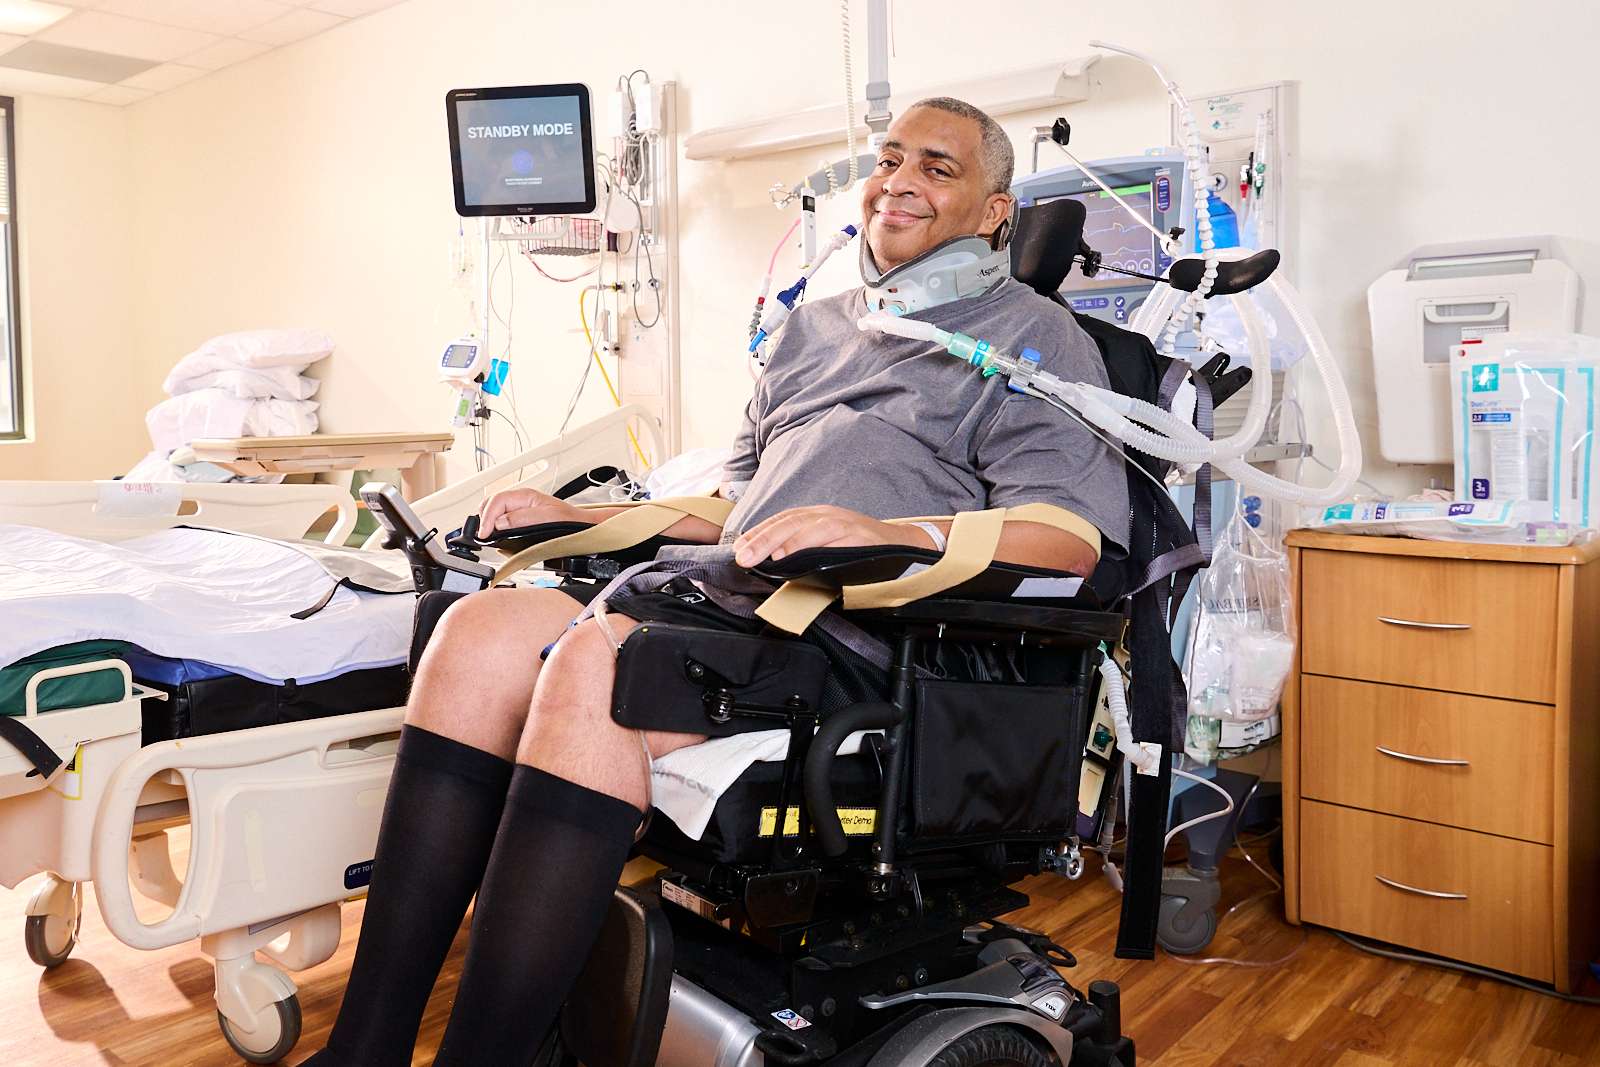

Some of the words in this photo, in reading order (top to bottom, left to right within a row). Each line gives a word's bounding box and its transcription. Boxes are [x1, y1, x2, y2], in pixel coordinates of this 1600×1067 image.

[468, 124, 530, 138] STANDBY
[533, 123, 573, 136] MODE
[977, 264, 1000, 279] Aspen
